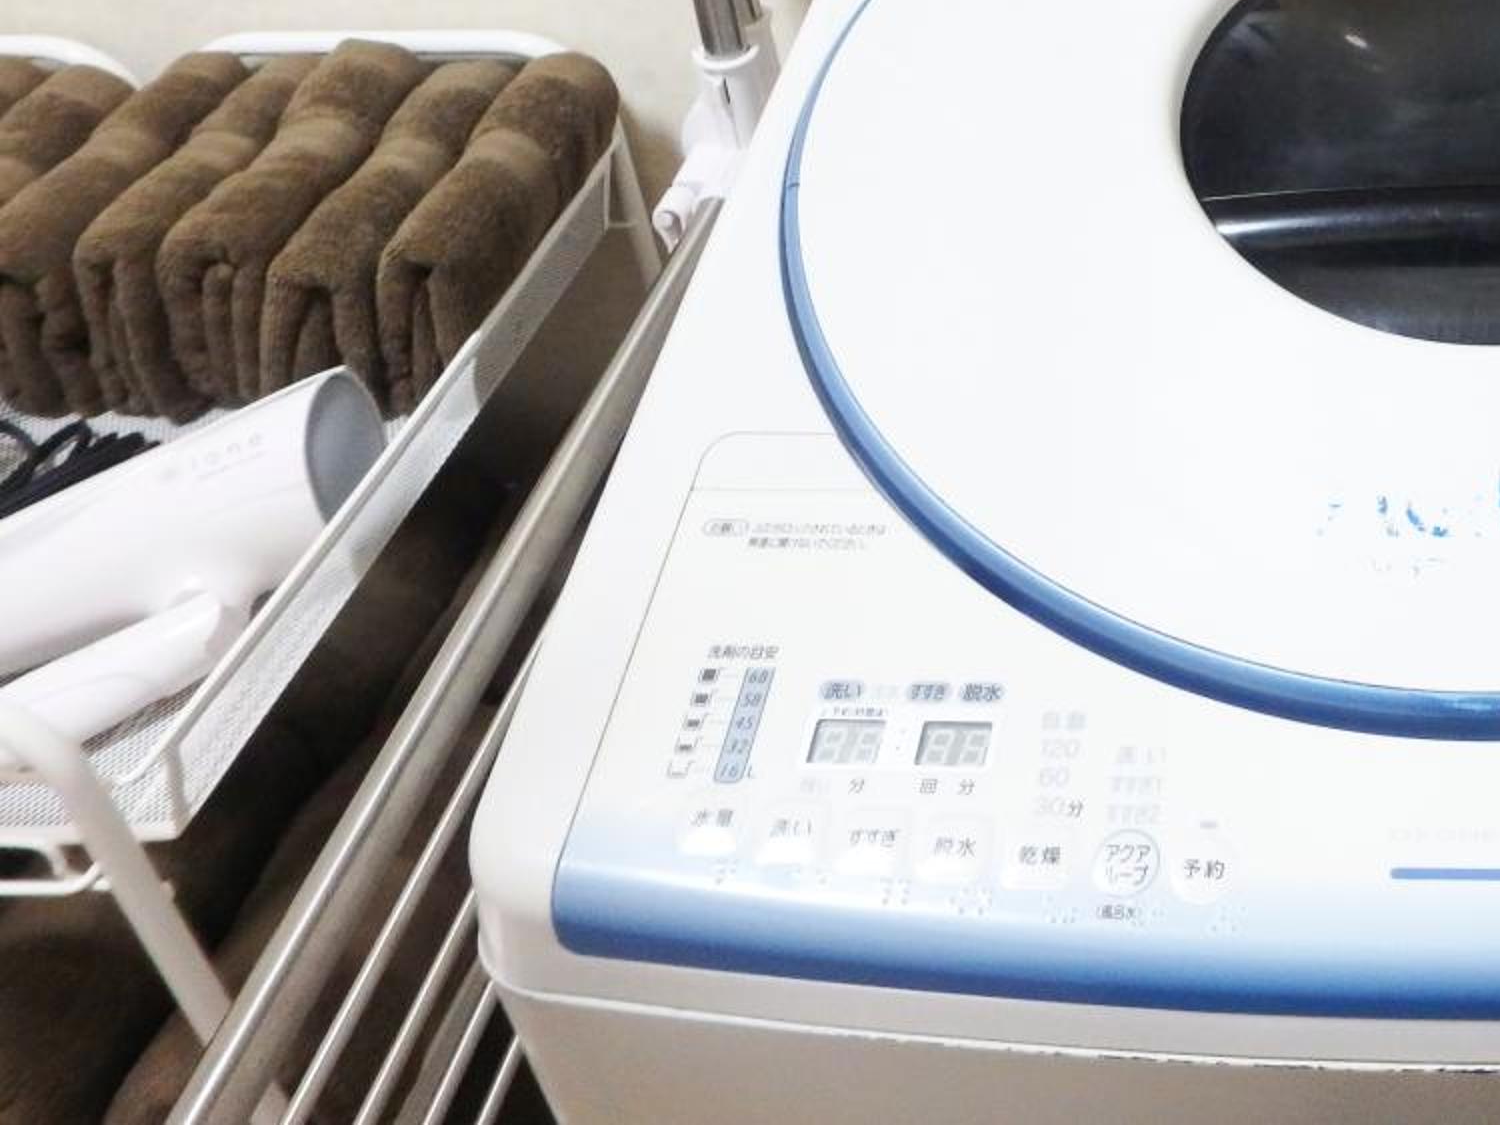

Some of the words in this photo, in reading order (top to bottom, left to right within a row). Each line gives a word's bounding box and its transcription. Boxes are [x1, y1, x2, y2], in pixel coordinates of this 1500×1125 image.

[962, 682, 1002, 702] 脱水
[1019, 845, 1062, 866] 乾燥
[1105, 843, 1152, 863] アクア
[1183, 858, 1226, 880] 予約
